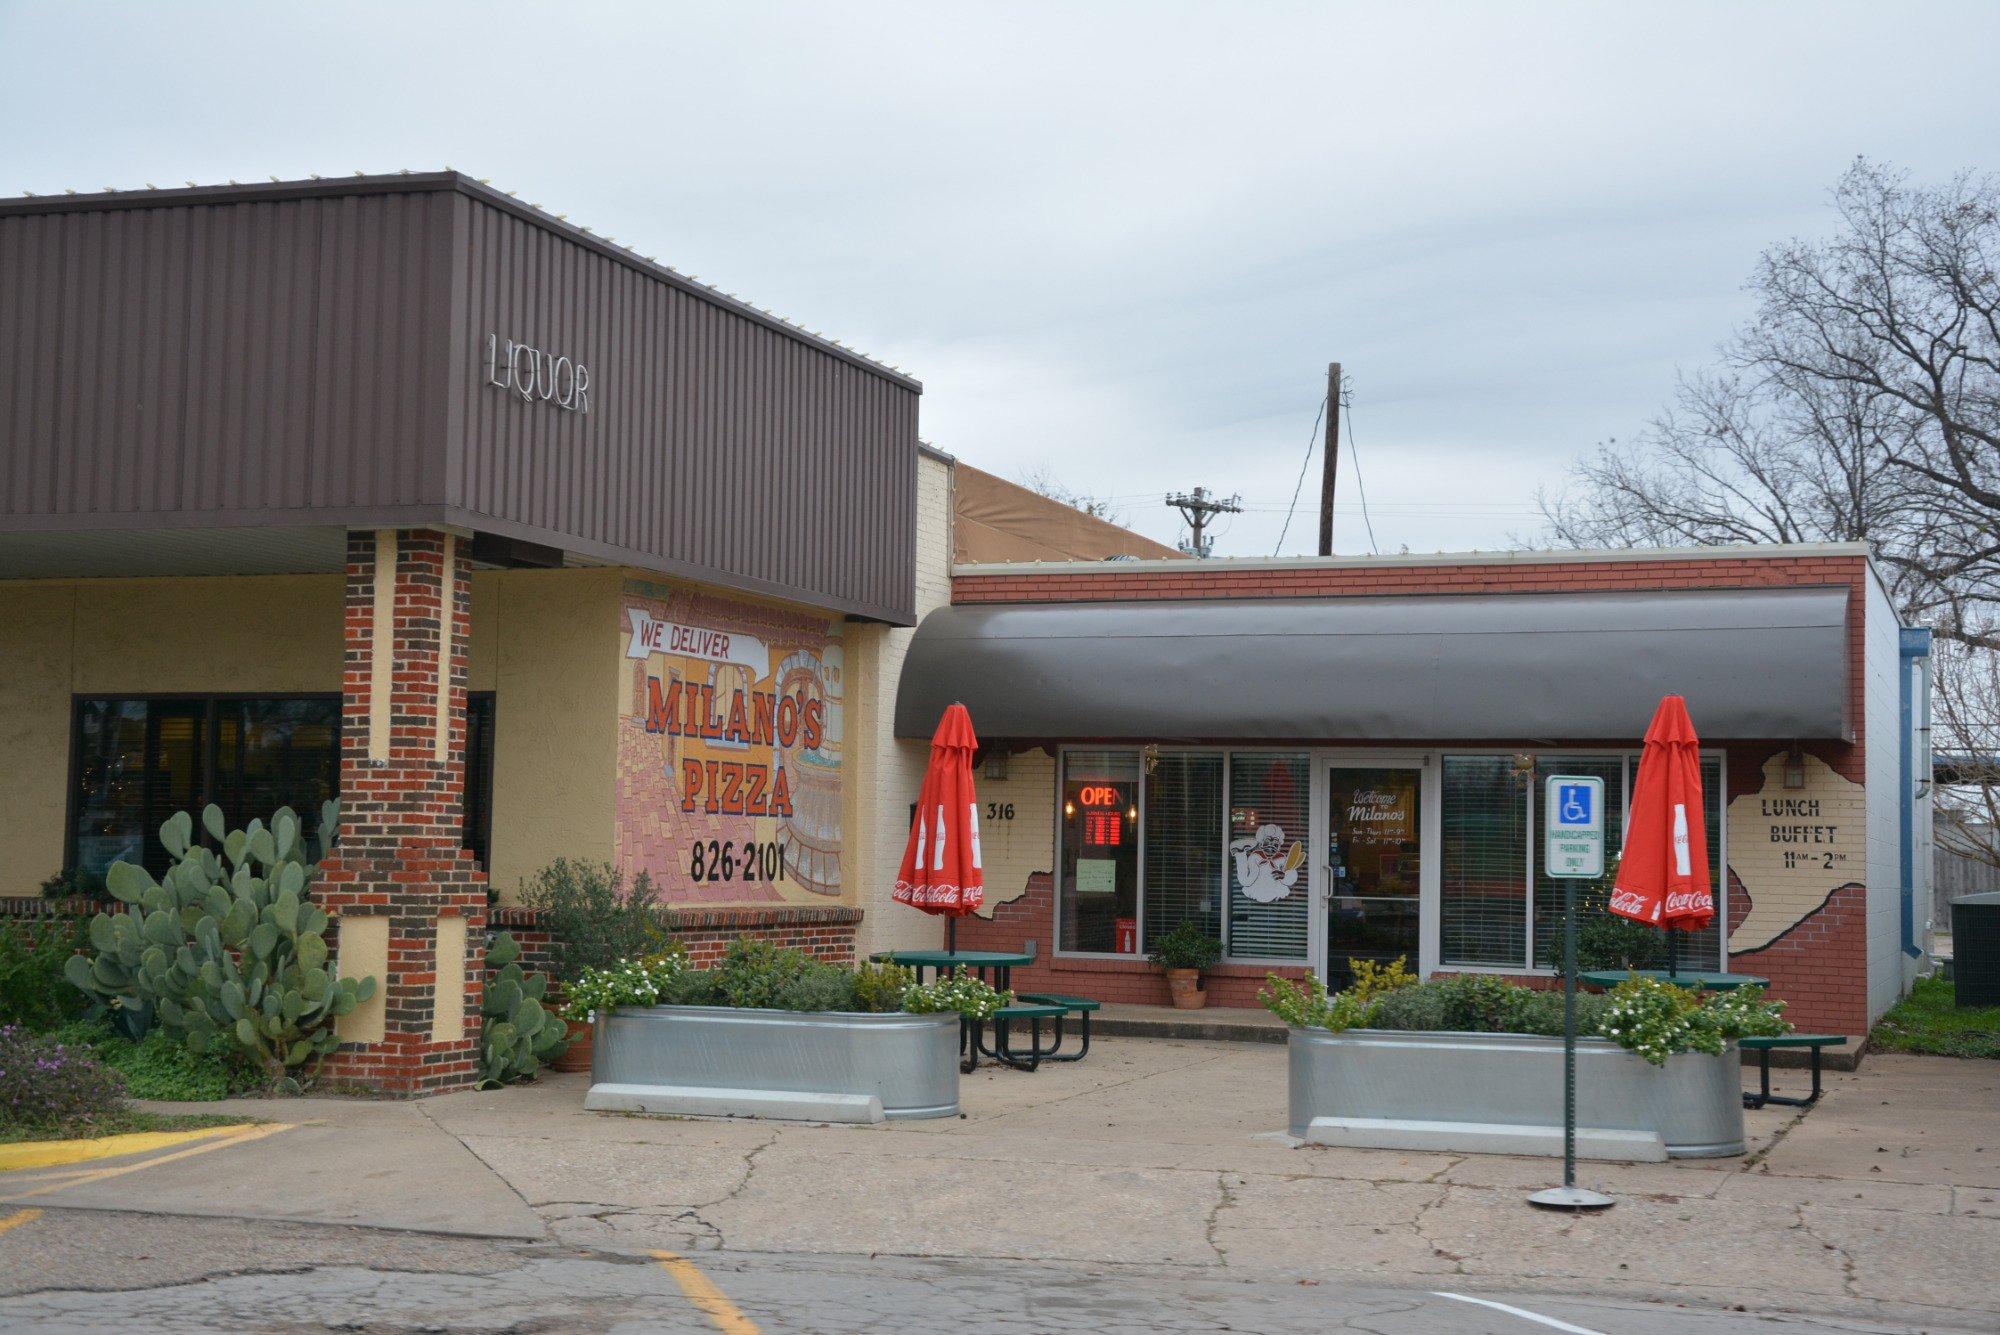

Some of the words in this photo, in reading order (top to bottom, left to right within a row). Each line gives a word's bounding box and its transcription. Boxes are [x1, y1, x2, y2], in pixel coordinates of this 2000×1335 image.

[490, 333, 589, 414] LIQUOR
[641, 620, 664, 648] WE
[671, 625, 730, 659] DELIVER
[645, 676, 824, 750] MILANO'S
[681, 757, 794, 818] PIZZA
[1080, 786, 1123, 806] OPEN
[1353, 788, 1397, 805] Welcome
[986, 803, 1015, 820] 316
[1761, 799, 1820, 817] LUNCH
[1552, 829, 1600, 840] HANDICAPPED
[1770, 825, 1837, 843] BUFFET
[1560, 843, 1590, 853] PARKING
[690, 840, 786, 882] 826-2101
[1566, 857, 1584, 867] ONLY
